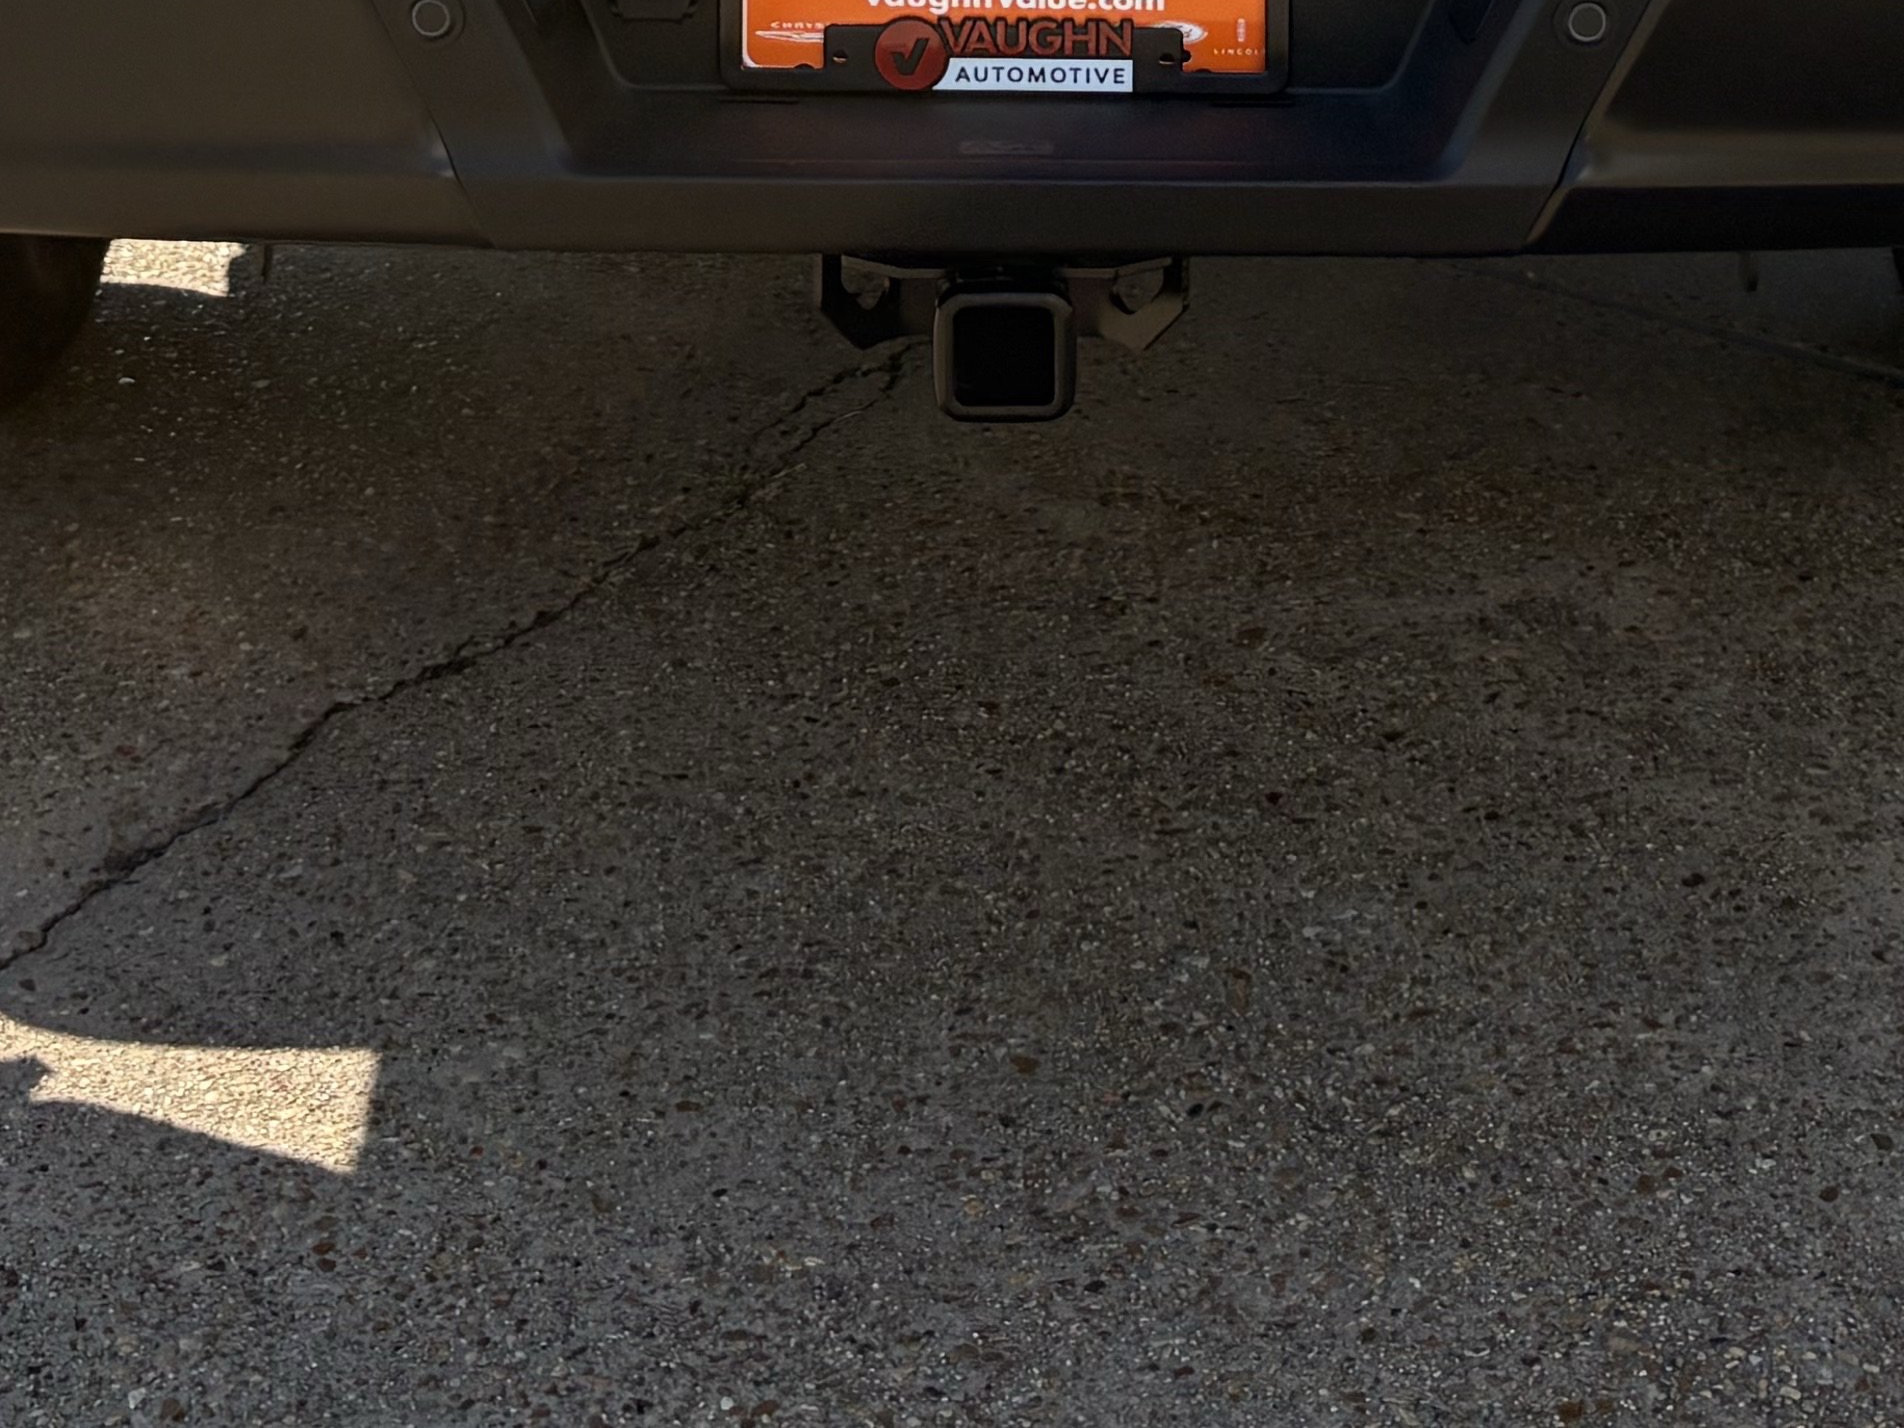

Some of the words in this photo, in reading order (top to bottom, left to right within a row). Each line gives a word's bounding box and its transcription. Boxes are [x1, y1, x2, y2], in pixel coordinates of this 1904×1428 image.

[939, 17, 1132, 57] VAUGHN
[1213, 48, 1259, 56] LINCOL
[955, 66, 1126, 85] AUTOMOTIVE
